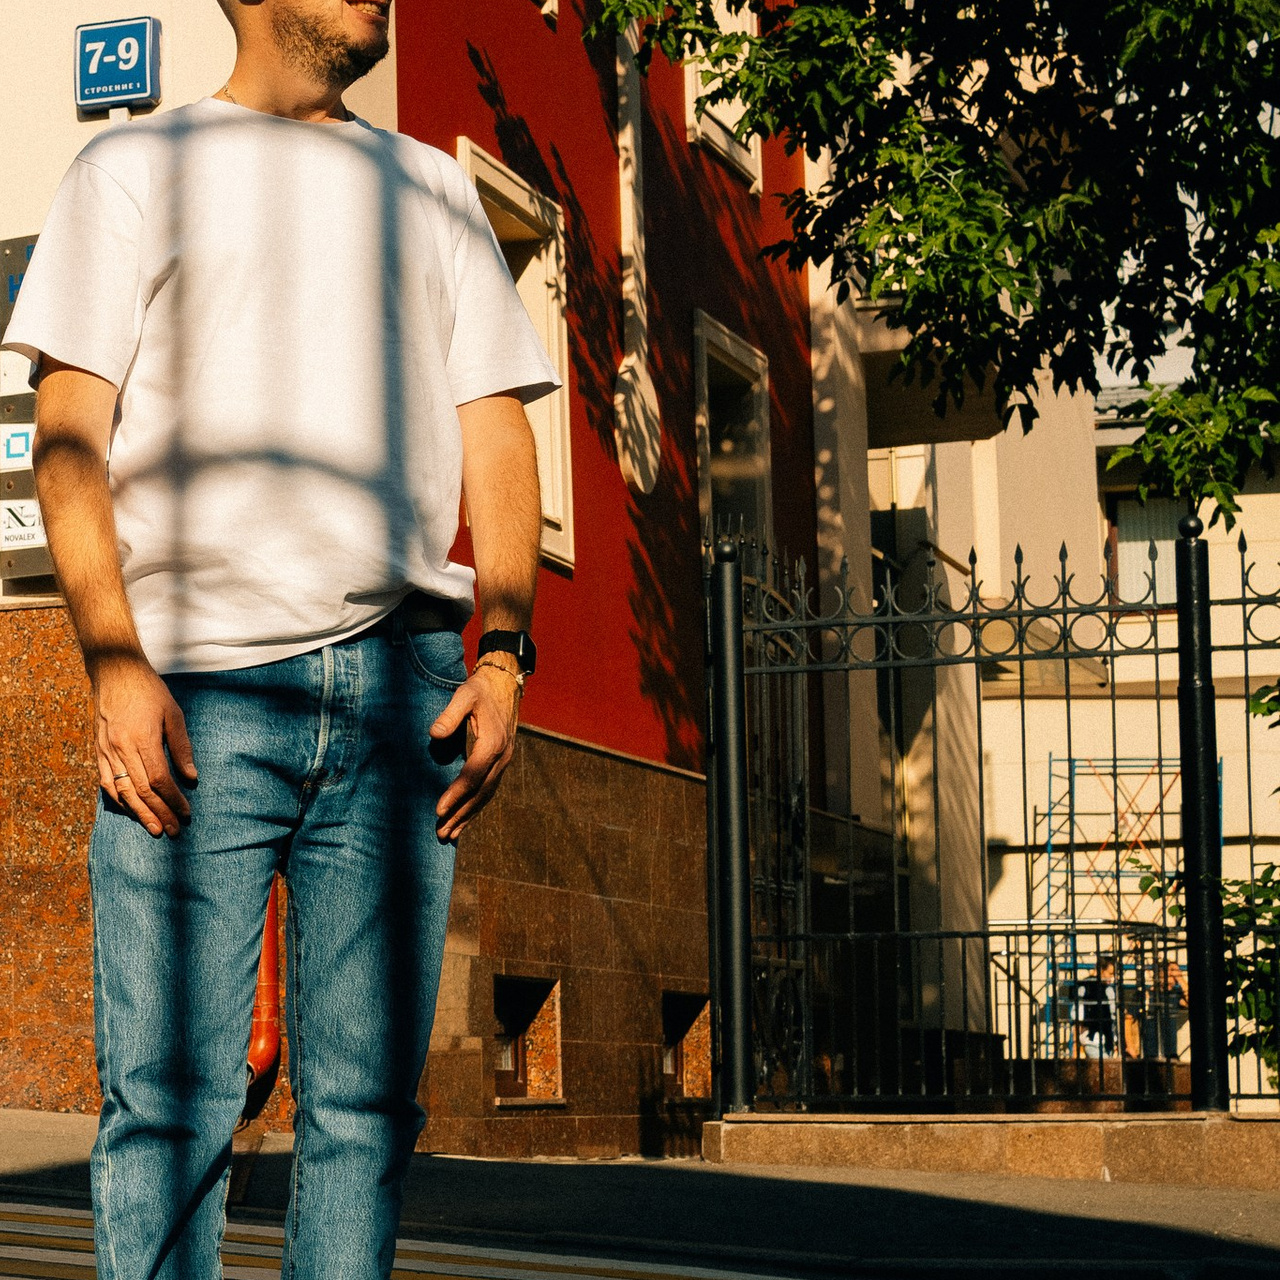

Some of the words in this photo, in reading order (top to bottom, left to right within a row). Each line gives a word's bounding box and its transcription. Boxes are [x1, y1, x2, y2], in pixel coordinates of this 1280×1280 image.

[85, 37, 139, 74] 7-9
[84, 82, 134, 95] СТРОЕНИЕ
[4, 533, 36, 542] NOVALEX
